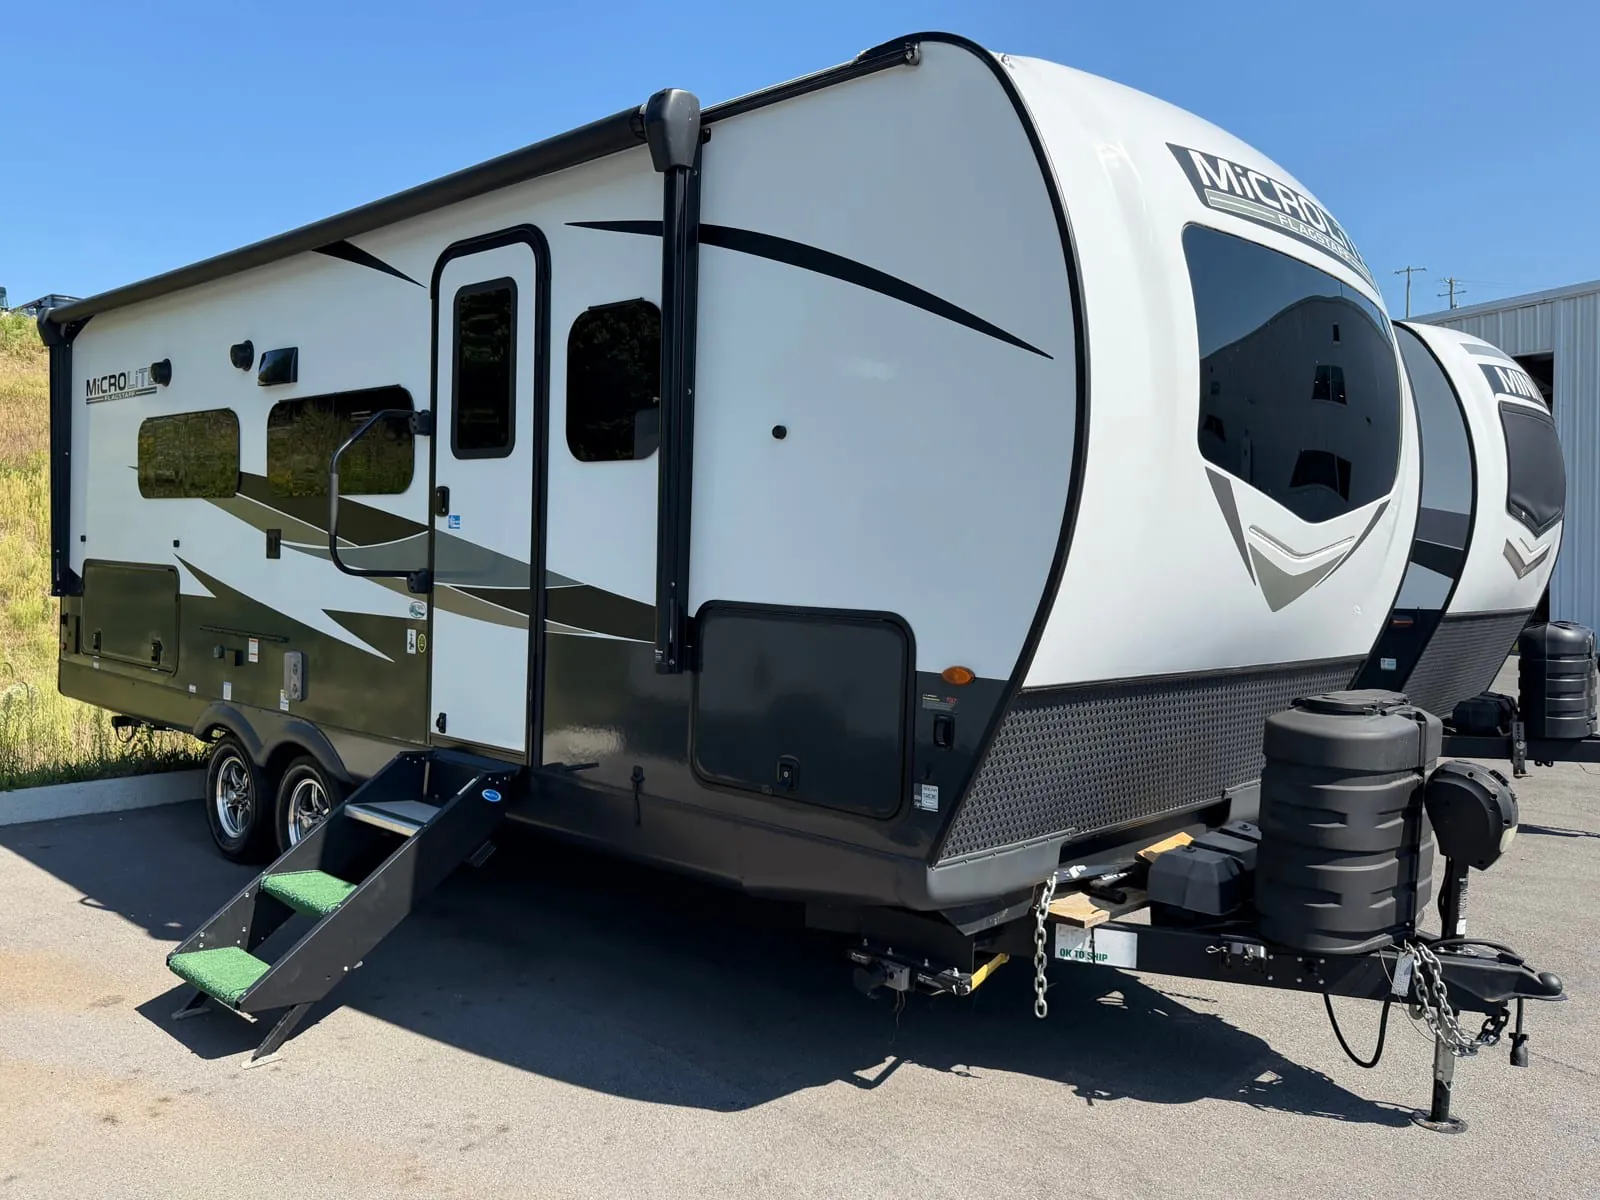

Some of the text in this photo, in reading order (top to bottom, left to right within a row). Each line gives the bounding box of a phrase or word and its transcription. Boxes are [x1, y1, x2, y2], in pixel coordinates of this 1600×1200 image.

[1187, 149, 1367, 267] MiCROLi
[1060, 948, 1108, 962] OK TO SHIP
